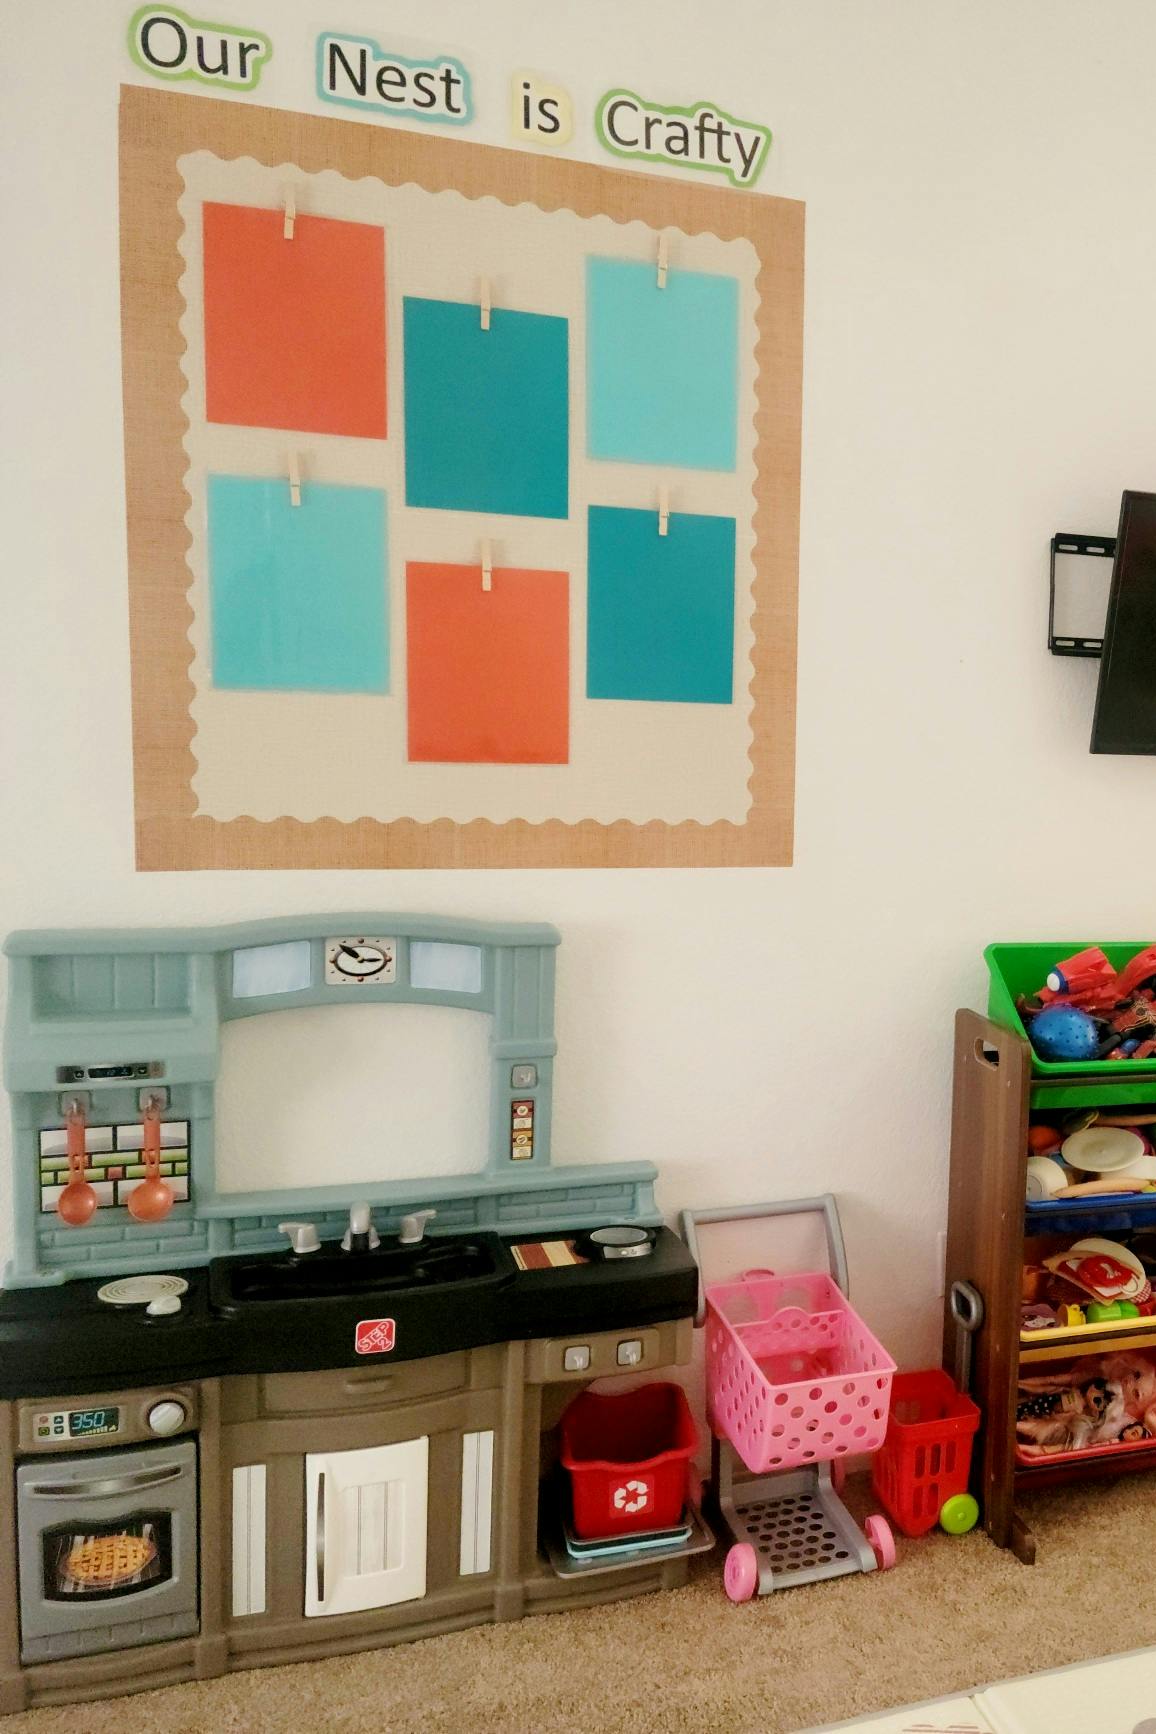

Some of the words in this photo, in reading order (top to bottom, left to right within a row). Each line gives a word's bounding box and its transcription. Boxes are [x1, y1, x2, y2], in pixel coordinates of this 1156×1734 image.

[140, 16, 260, 78] Our
[328, 43, 461, 114] Nest
[523, 82, 559, 134] is
[607, 100, 761, 178] Crafty
[358, 1321, 389, 1351] STEP
[378, 1337, 392, 1350] 2
[72, 1411, 105, 1429] 350
